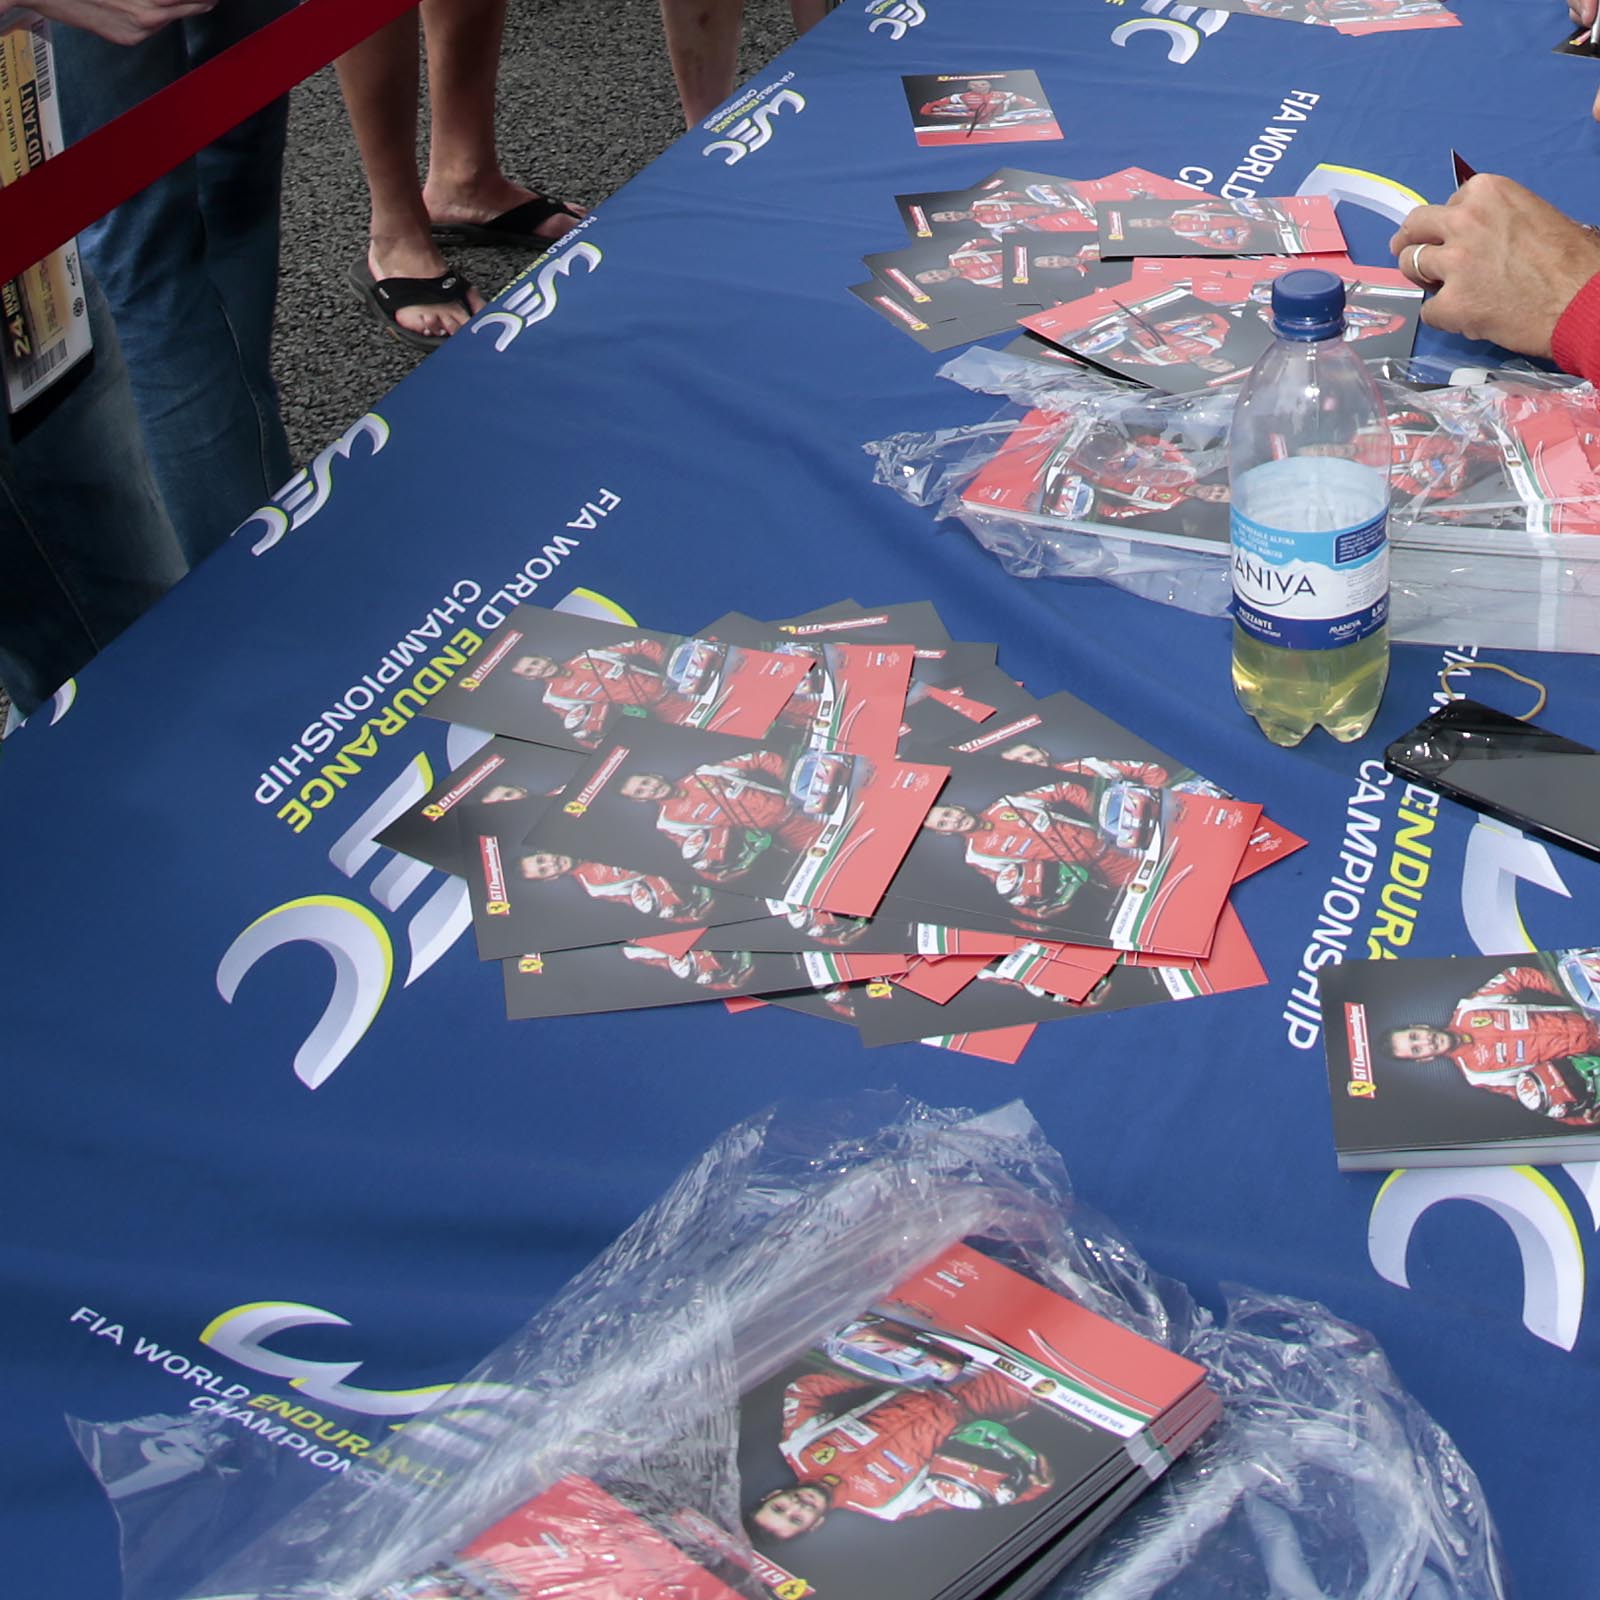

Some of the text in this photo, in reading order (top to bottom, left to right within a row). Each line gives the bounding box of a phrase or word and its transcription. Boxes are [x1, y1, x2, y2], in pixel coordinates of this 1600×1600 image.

[1221, 88, 1320, 200] FIA WORLD
[8, 314, 32, 358] 24
[471, 241, 603, 352] WEC
[230, 412, 390, 556] WEC
[1235, 553, 1317, 597] ANIVA
[255, 579, 483, 805] CHAMPIONSHIP
[276, 487, 621, 833] FIA WORLD ENDURANCE
[1354, 1063, 1368, 1082] GT
[70, 1306, 125, 1346] FIA
[132, 1336, 250, 1400] WORLD
